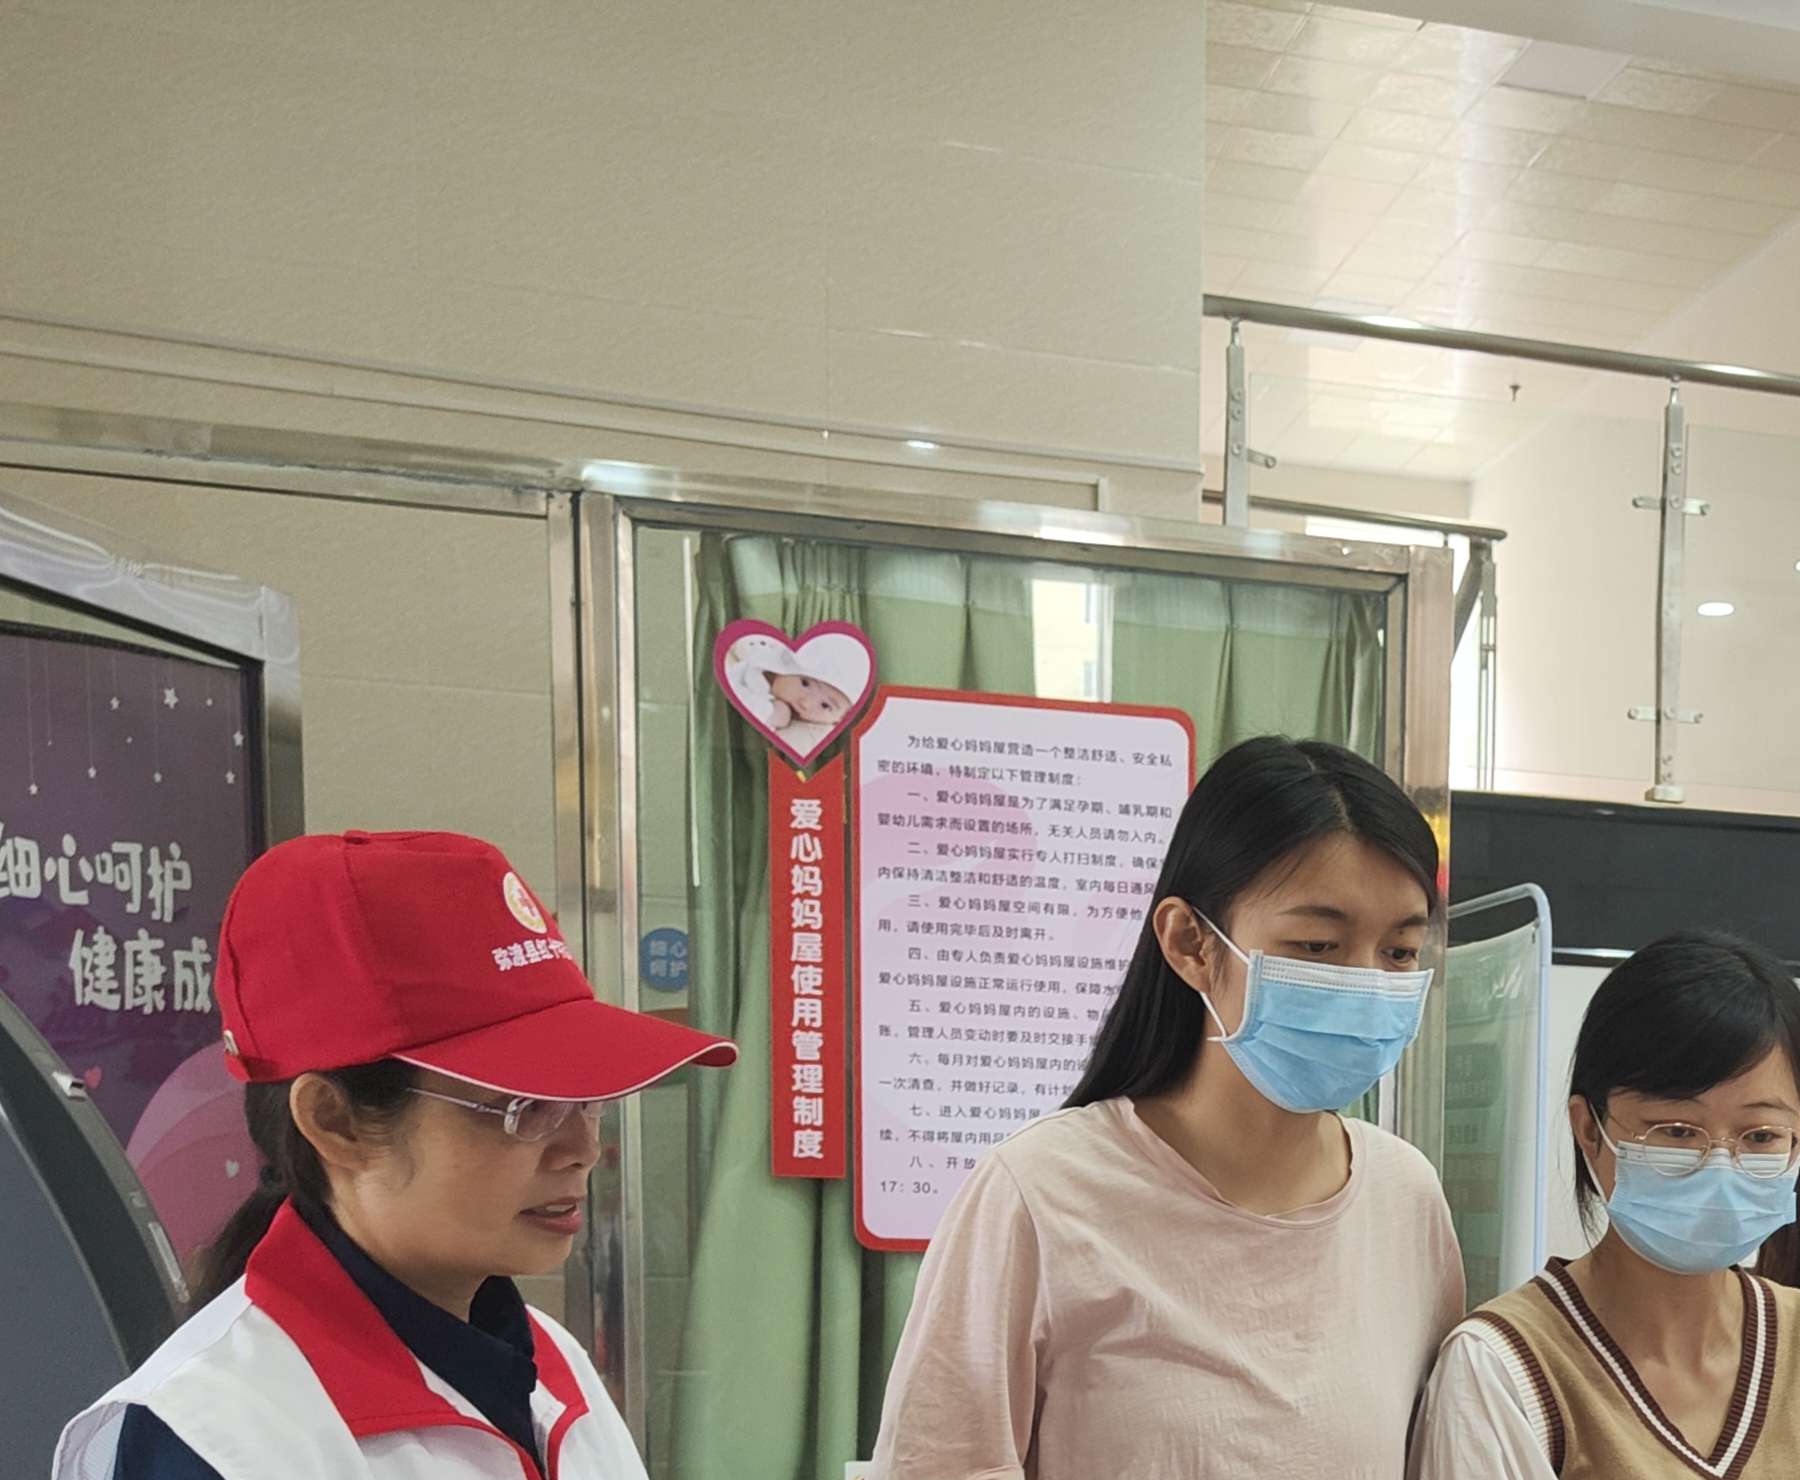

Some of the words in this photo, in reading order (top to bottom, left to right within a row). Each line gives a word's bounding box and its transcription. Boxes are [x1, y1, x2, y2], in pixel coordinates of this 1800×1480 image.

[0, 823, 193, 923] 细心呵护
[907, 842, 1164, 870] 二、爱心妈妈屋实行专人打扫制度，确保
[68, 926, 212, 1015] 健康成
[790, 798, 823, 1160] 爱心妈妈屋使用管理制度
